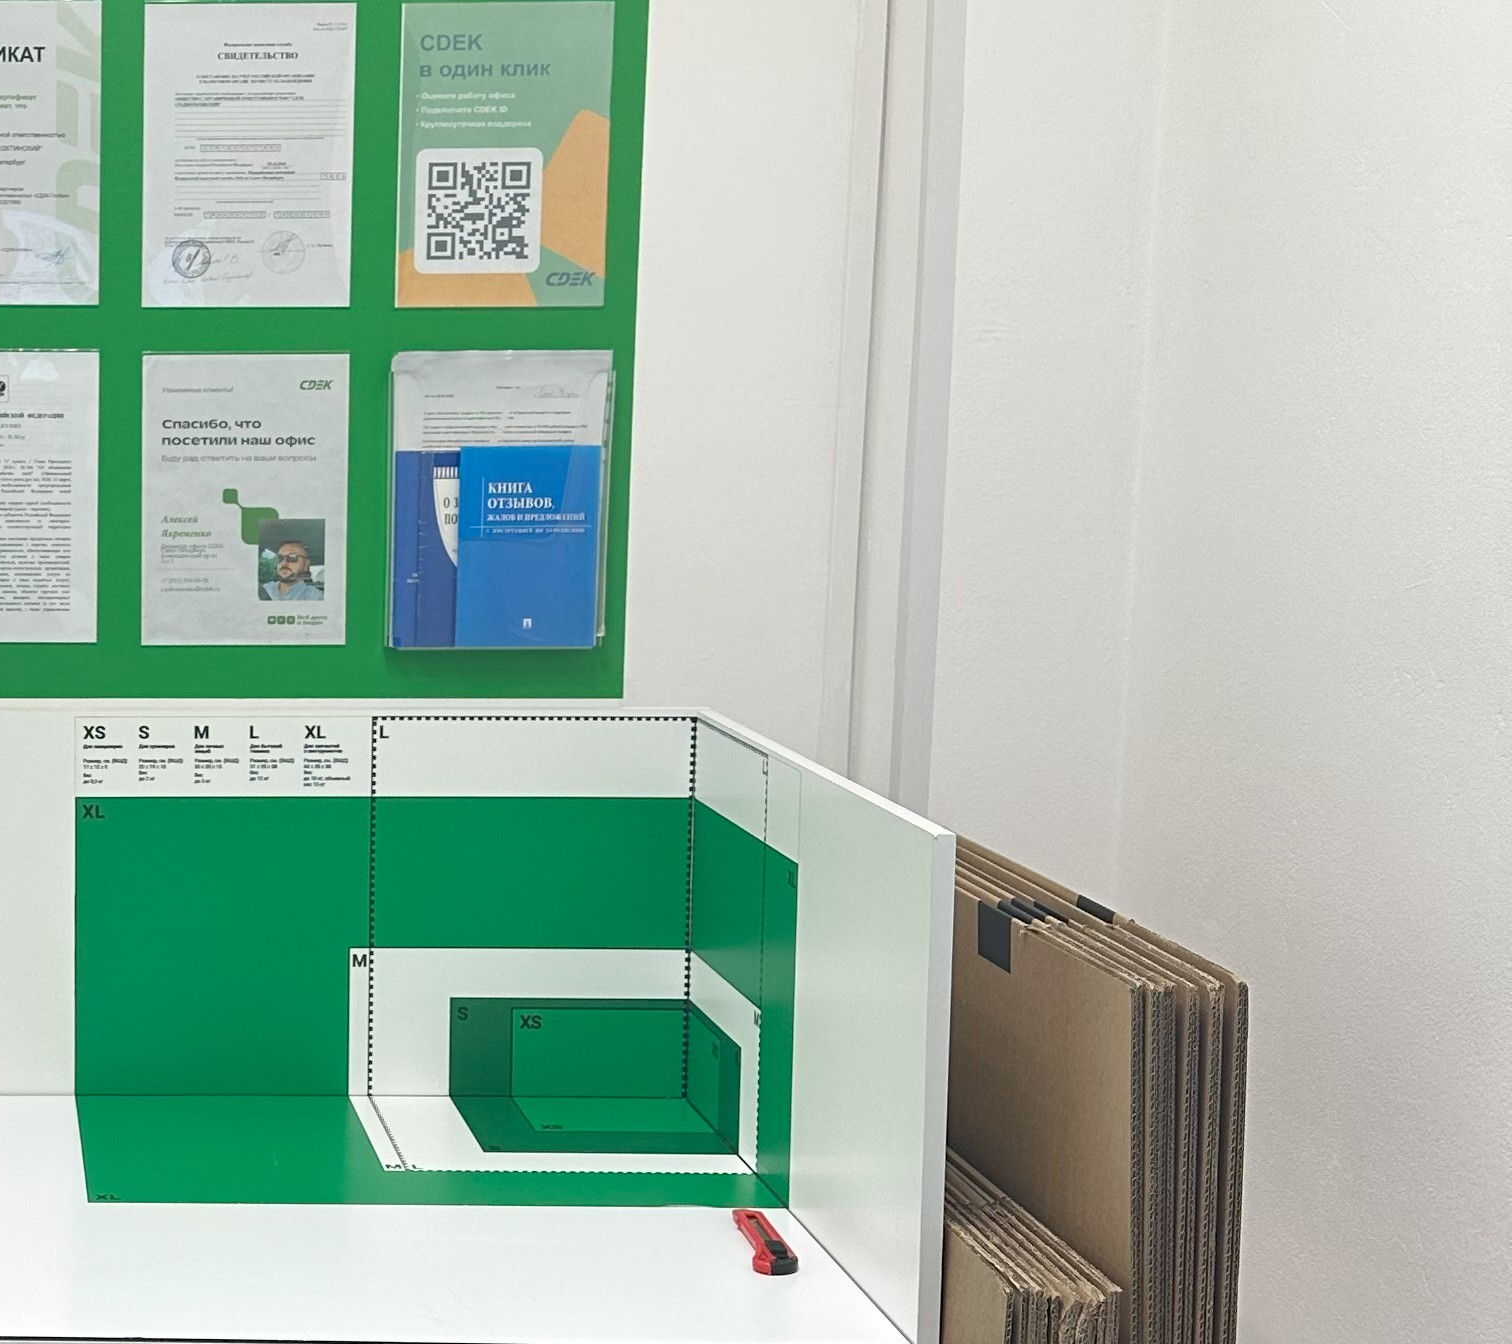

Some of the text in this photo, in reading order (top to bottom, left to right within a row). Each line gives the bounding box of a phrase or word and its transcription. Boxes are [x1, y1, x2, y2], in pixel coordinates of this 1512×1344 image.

[420, 33, 483, 51] CDEK
[216, 51, 299, 61] СВИДЕТЕЛЬСТВО
[419, 63, 551, 80] в один клик
[544, 271, 596, 287] CDEK
[300, 380, 334, 391] CDEK
[162, 419, 262, 431] Спасибо, что
[161, 436, 316, 447] посетили наш офис
[487, 482, 533, 494] КНИГА
[487, 497, 556, 510] ОТЗЫВОВ,
[82, 725, 106, 739] XS
[138, 725, 150, 739] S
[194, 725, 209, 739] M
[249, 725, 259, 739] L
[304, 725, 327, 739] XL
[379, 725, 390, 739] L
[82, 804, 105, 819] XL
[352, 954, 367, 967] M
[457, 1006, 468, 1020] S
[519, 1014, 542, 1029] XS
